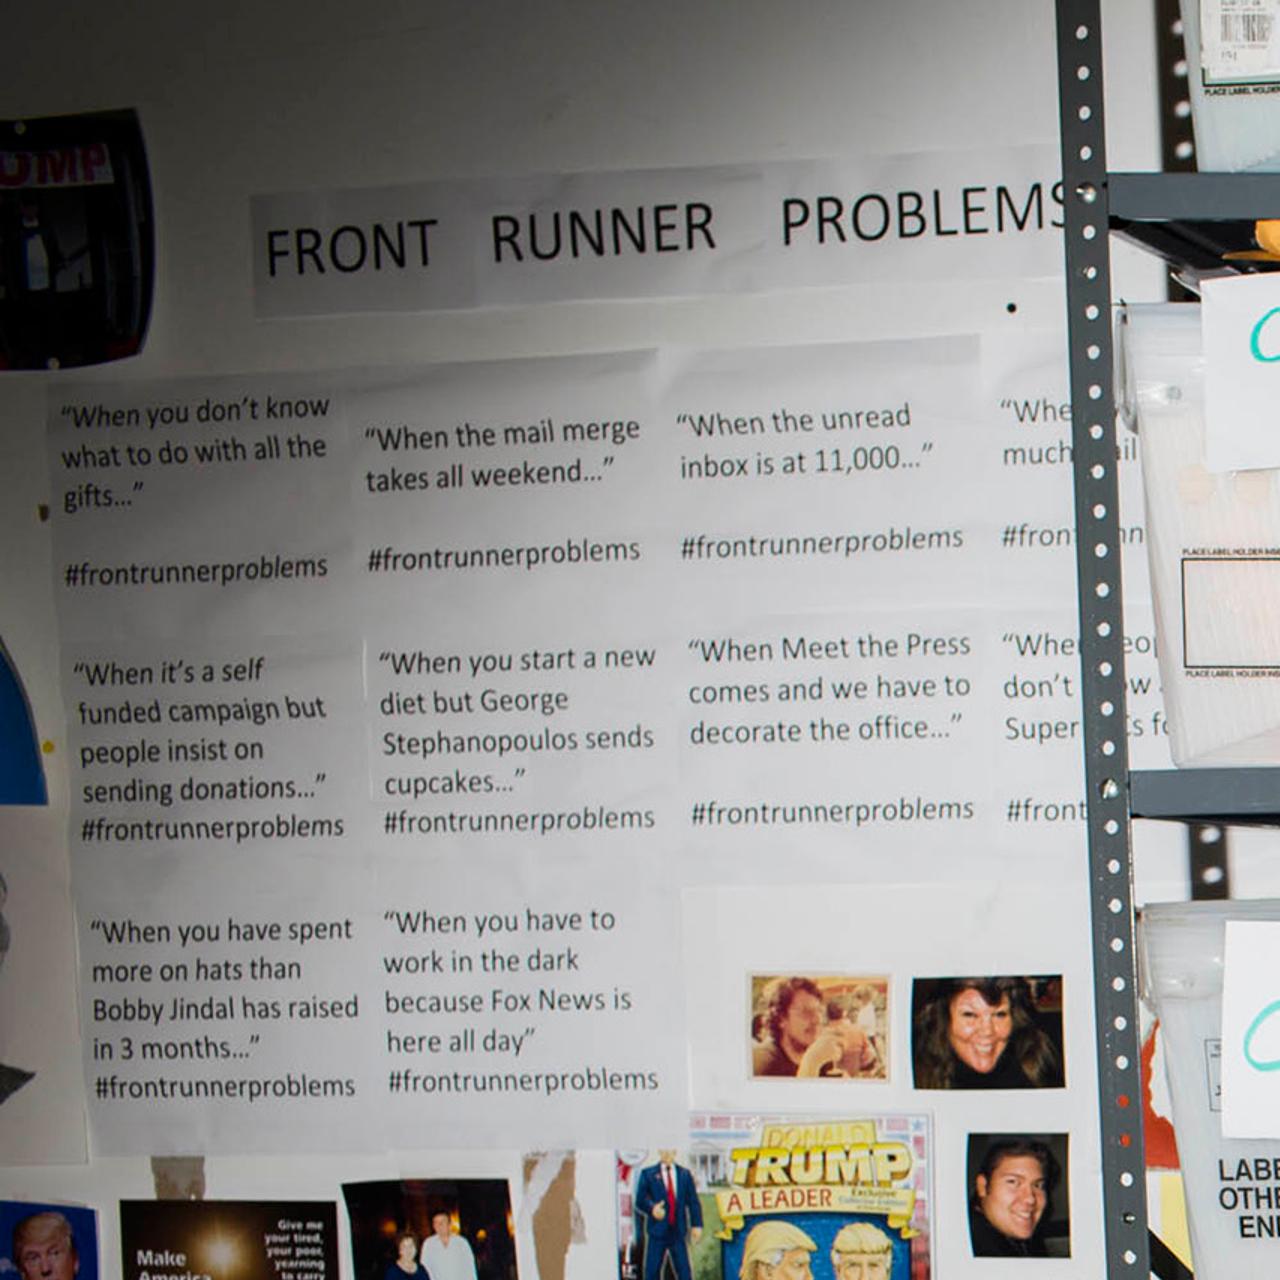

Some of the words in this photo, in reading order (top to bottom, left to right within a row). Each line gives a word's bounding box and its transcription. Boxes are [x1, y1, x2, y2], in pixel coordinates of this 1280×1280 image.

[265, 217, 438, 279] FRONT
[490, 200, 718, 266] RUNNER
[782, 636, 850, 661] Meet
[858, 634, 899, 659] the
[907, 632, 972, 657] Press
[689, 680, 770, 704] comes
[778, 677, 823, 703] and
[831, 678, 869, 700] we
[876, 675, 938, 699] have
[944, 674, 972, 698] to
[690, 718, 802, 745] decorate
[810, 716, 850, 742] the
[691, 796, 975, 827] #frontrunnerproblems
[475, 910, 518, 937] you
[526, 909, 582, 932] have
[591, 909, 616, 931] to
[383, 950, 444, 974] work
[451, 950, 474, 973] in
[480, 950, 520, 972] the
[527, 947, 579, 971] dark
[385, 989, 483, 1016] because
[491, 988, 531, 1013] Fox
[537, 987, 605, 1012] News
[612, 987, 632, 1011] is
[387, 1031, 442, 1055] here
[449, 1029, 476, 1053] all
[388, 1067, 660, 1095] #frontrunnerproblems
[731, 1143, 912, 1188] TRUMP
[727, 1192, 743, 1213] A
[751, 1187, 832, 1210] LEADER
[136, 1250, 187, 1268] Make
